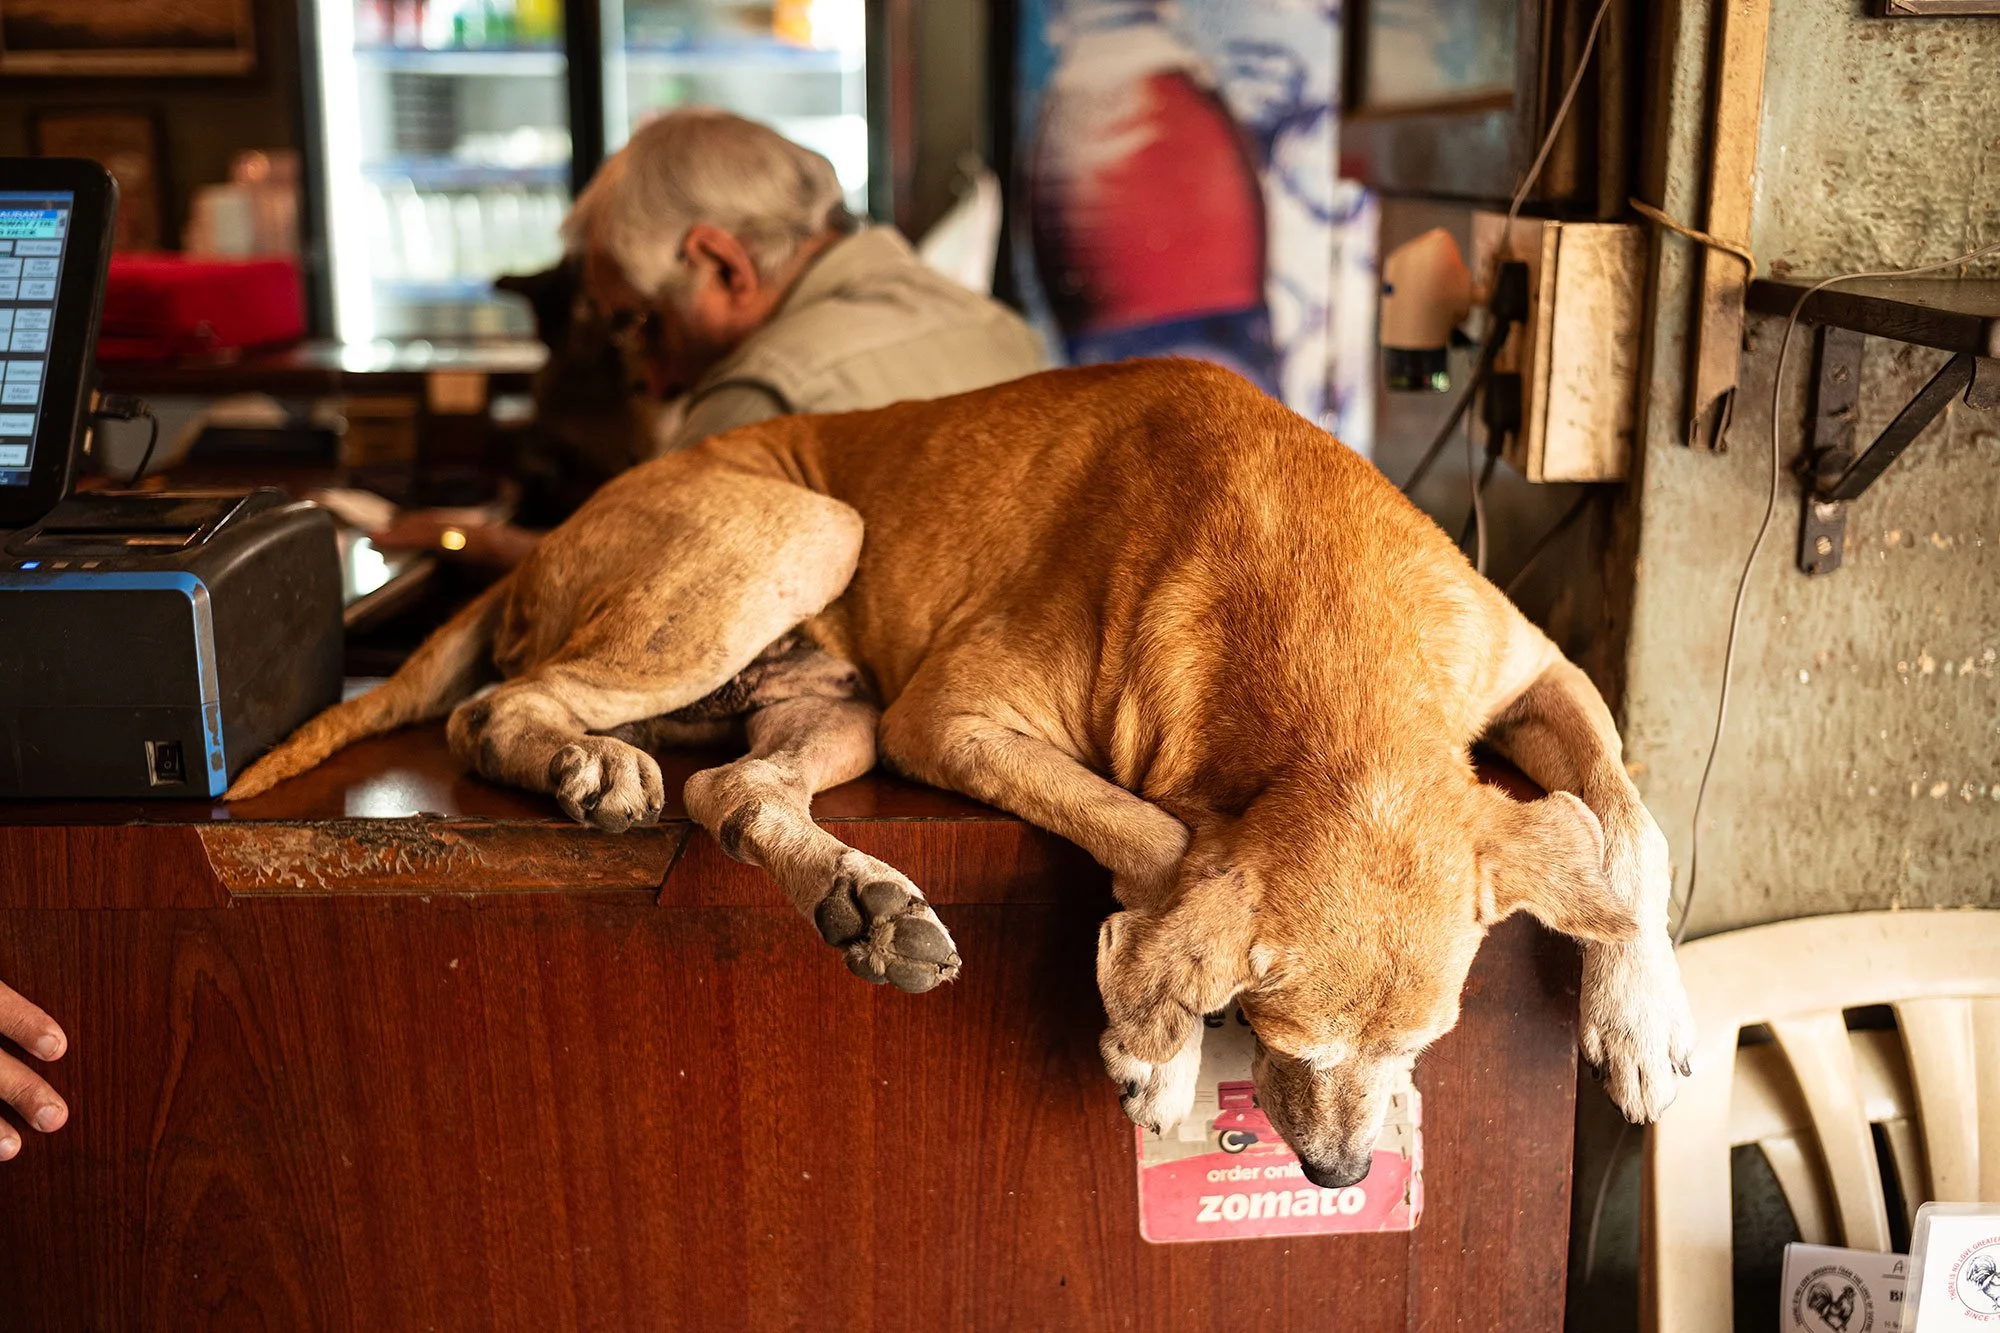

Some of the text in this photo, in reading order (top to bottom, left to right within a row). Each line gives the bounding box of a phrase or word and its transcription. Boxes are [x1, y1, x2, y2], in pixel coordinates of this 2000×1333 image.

[1207, 1161, 1304, 1182] order onli
[1196, 1187, 1367, 1223] zomato
[1952, 1262, 1960, 1272] NO
[1959, 1247, 1973, 1262] LOVE
[1964, 1309, 1989, 1322] SINCE
